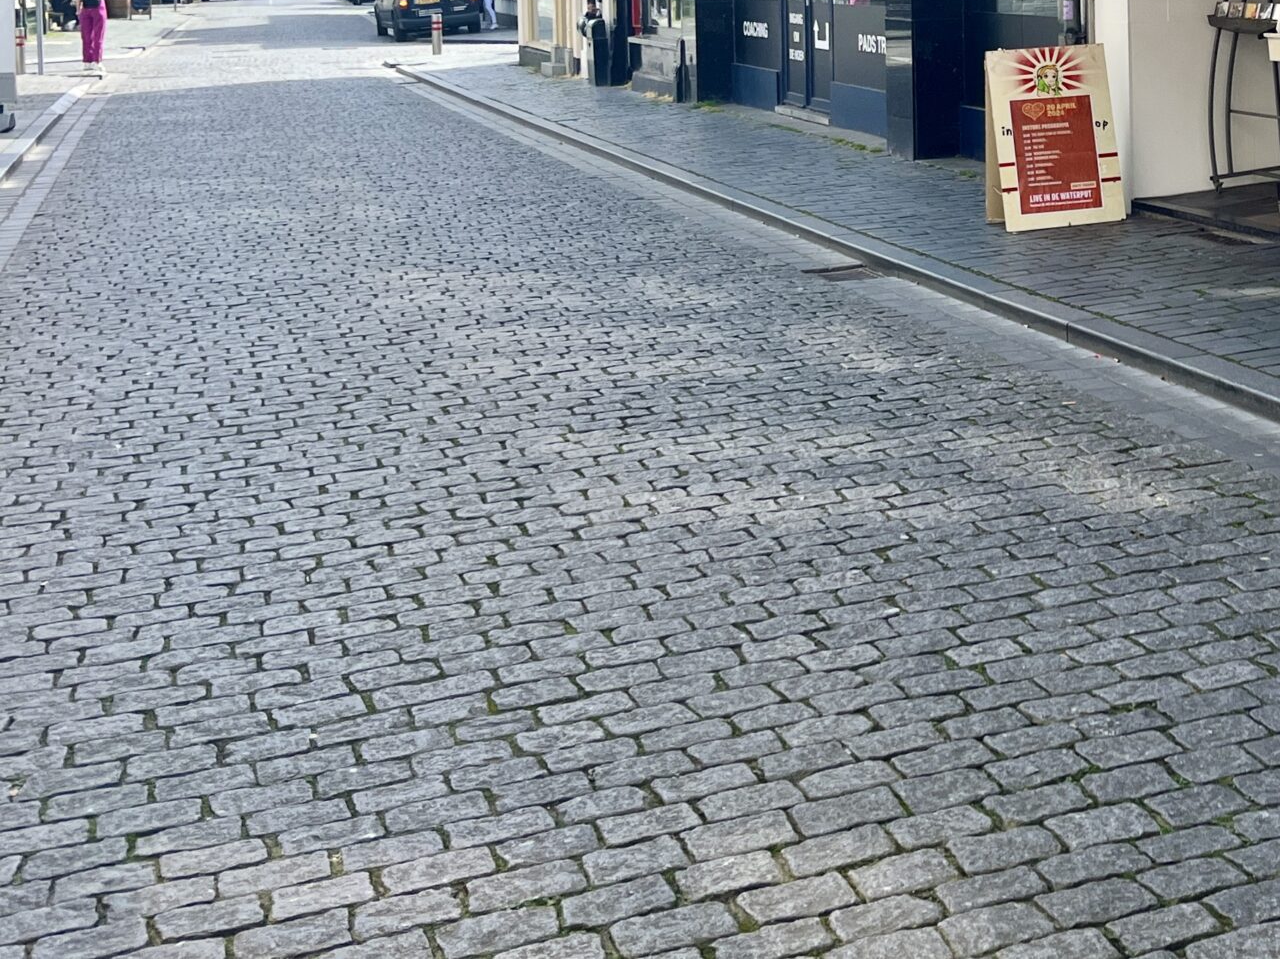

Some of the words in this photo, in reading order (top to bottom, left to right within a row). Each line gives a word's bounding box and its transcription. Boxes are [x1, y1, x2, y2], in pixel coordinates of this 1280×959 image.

[743, 20, 769, 39] COACHING
[858, 33, 877, 54] PADS
[1029, 194, 1043, 203] LIVE
[1044, 193, 1051, 202] IN
[1051, 192, 1060, 201] DE
[1060, 190, 1092, 200] WATERPUT
